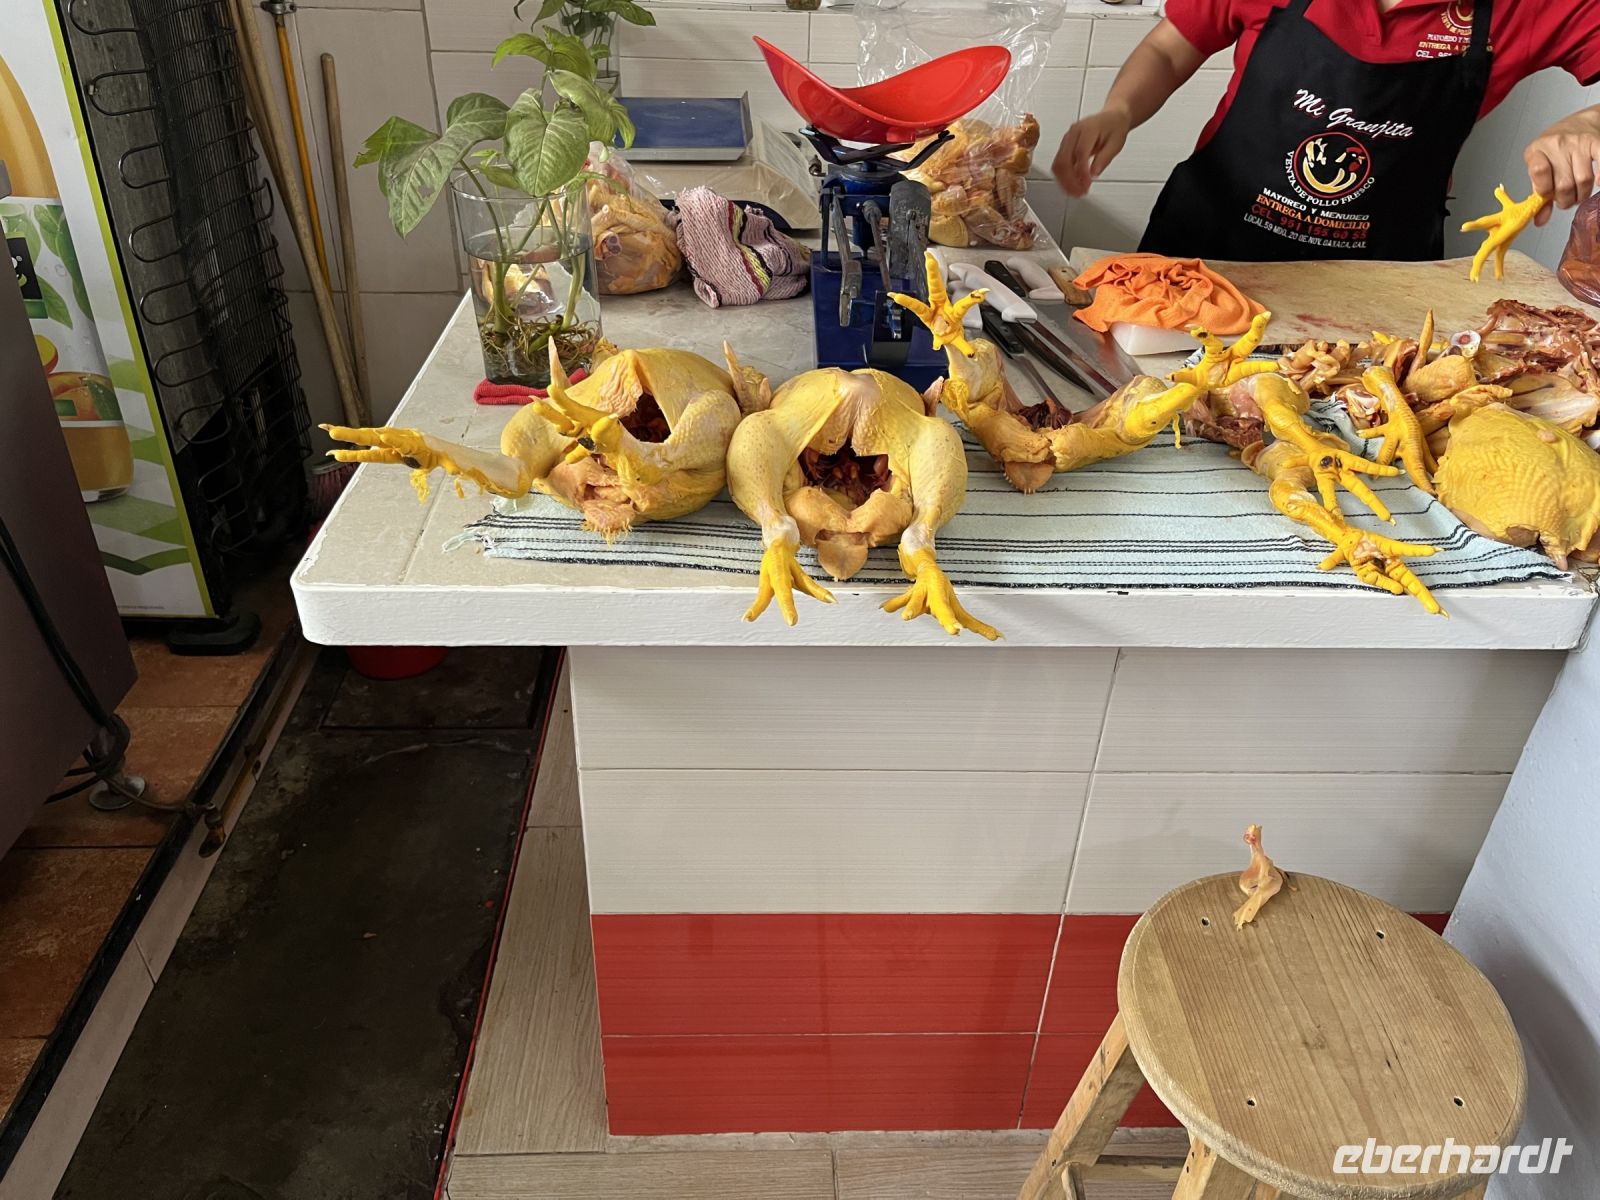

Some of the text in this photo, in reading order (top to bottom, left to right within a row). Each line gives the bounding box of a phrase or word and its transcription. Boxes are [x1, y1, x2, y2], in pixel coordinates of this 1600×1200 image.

[1418, 41, 1451, 51] ENTREGA
[1293, 88, 1413, 139] Mi Granjita
[1285, 150, 1375, 207] VENTA DE POLLO FRESCO
[1255, 193, 1370, 230] ENTREGA A DOMICILIO
[1263, 187, 1370, 221] MAYOREO Y MENUDEO
[1243, 212, 1264, 228] LOCAL
[1298, 234, 1309, 243] DE
